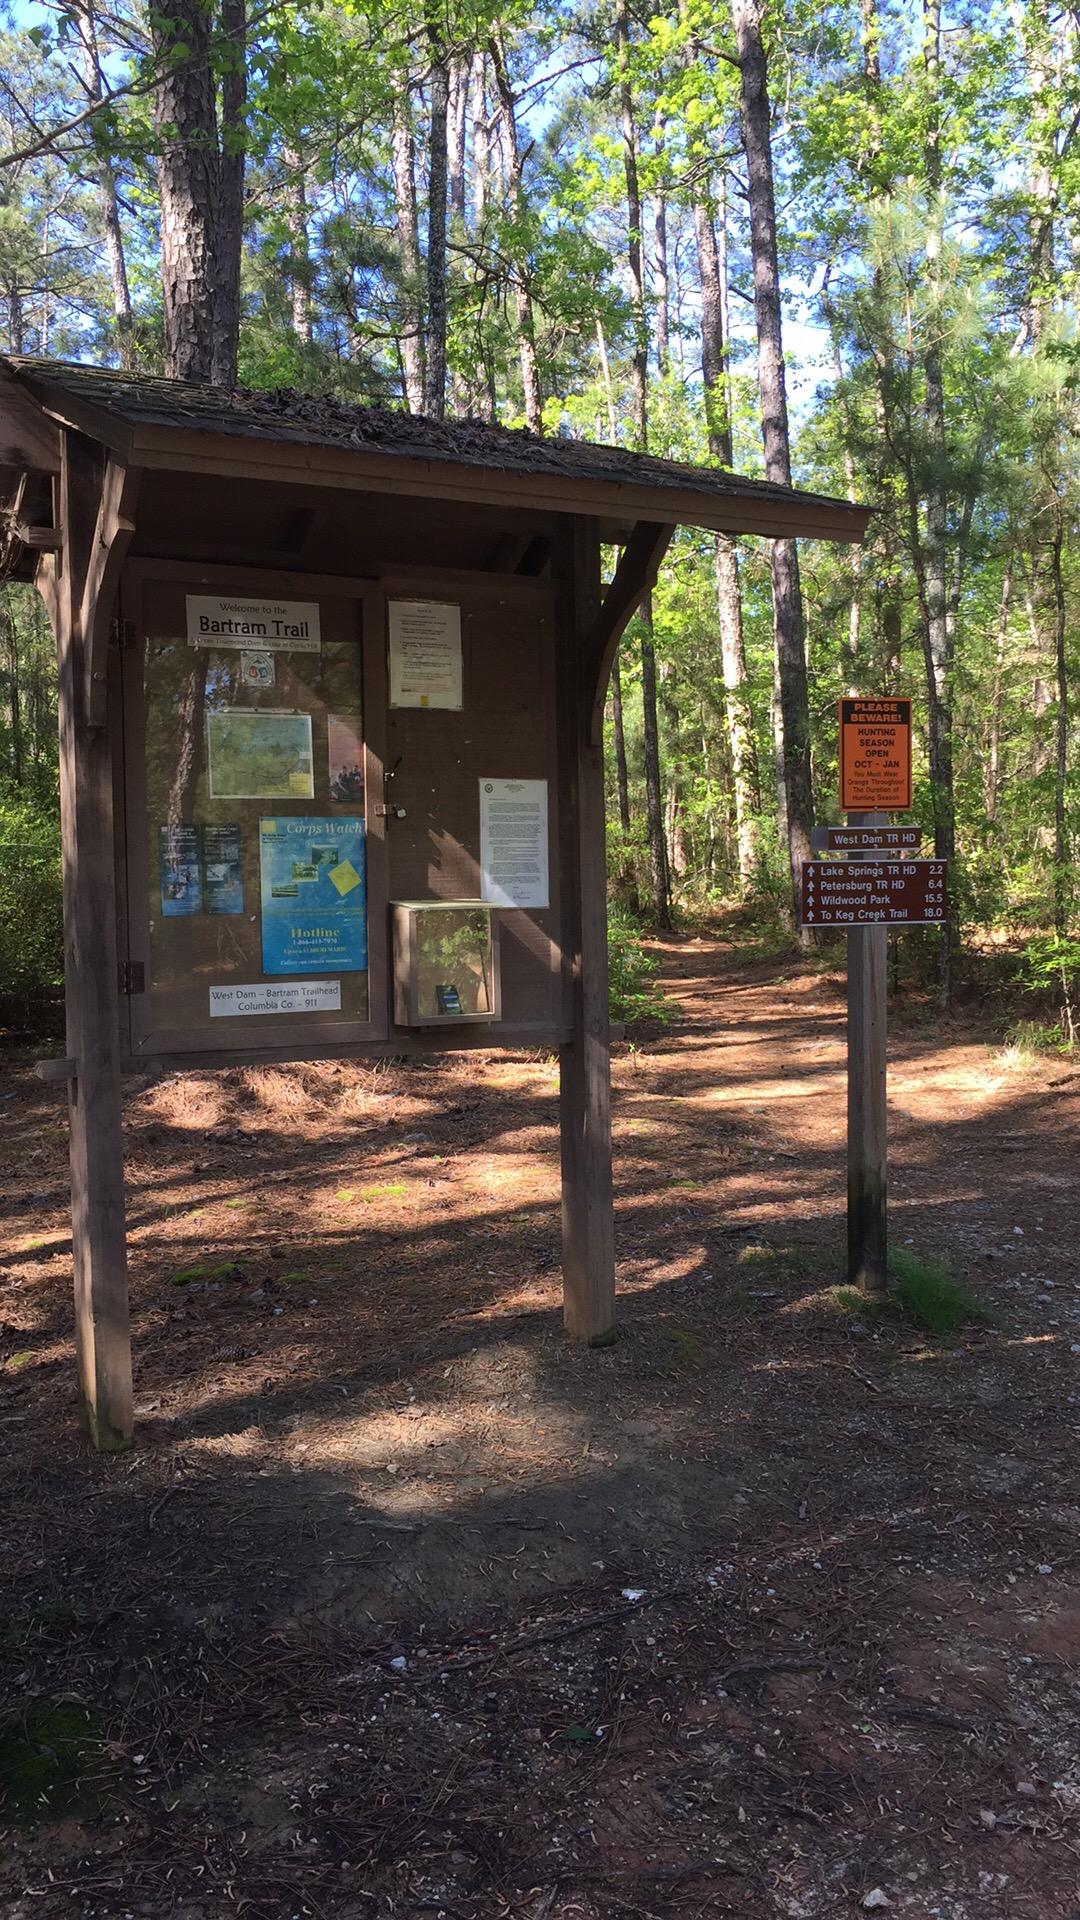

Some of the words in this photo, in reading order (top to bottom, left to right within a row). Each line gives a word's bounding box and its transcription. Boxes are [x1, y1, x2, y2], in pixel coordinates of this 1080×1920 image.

[220, 603, 259, 614] Welcome
[274, 607, 288, 615] the
[200, 616, 266, 635] Bartram
[272, 620, 309, 637] Trail
[854, 703, 898, 712] PLEASE
[850, 714, 902, 722] BEWARE!
[286, 823, 322, 836] Corps
[326, 822, 362, 834] Watch
[834, 835, 858, 844] West
[862, 834, 882, 844] Dam
[886, 834, 898, 842] TR
[902, 834, 916, 842] HD
[820, 866, 844, 876] Lake
[848, 866, 884, 877] Springs
[888, 866, 900, 874] TR
[903, 866, 916, 874] HD
[929, 865, 943, 874] 2.2
[820, 880, 872, 891] Petersburg
[876, 880, 888, 889] TR
[892, 880, 905, 890] HD
[928, 880, 943, 888] 6.4
[820, 895, 866, 904] Wildwood
[870, 894, 890, 904] Park
[924, 894, 943, 902] 15.5
[820, 910, 832, 920] To
[836, 910, 854, 920] Keg
[858, 909, 886, 920] Creek
[889, 908, 908, 918] Trail
[924, 908, 942, 918] 18.0
[290, 928, 340, 938] Hotline
[212, 992, 233, 1000] West
[236, 990, 256, 998] Dam
[266, 988, 298, 998] Bartram
[301, 986, 338, 996] Trailhead
[238, 1000, 278, 1010] Columbia
[280, 1000, 295, 1008] Co.
[304, 999, 318, 1008] 911
